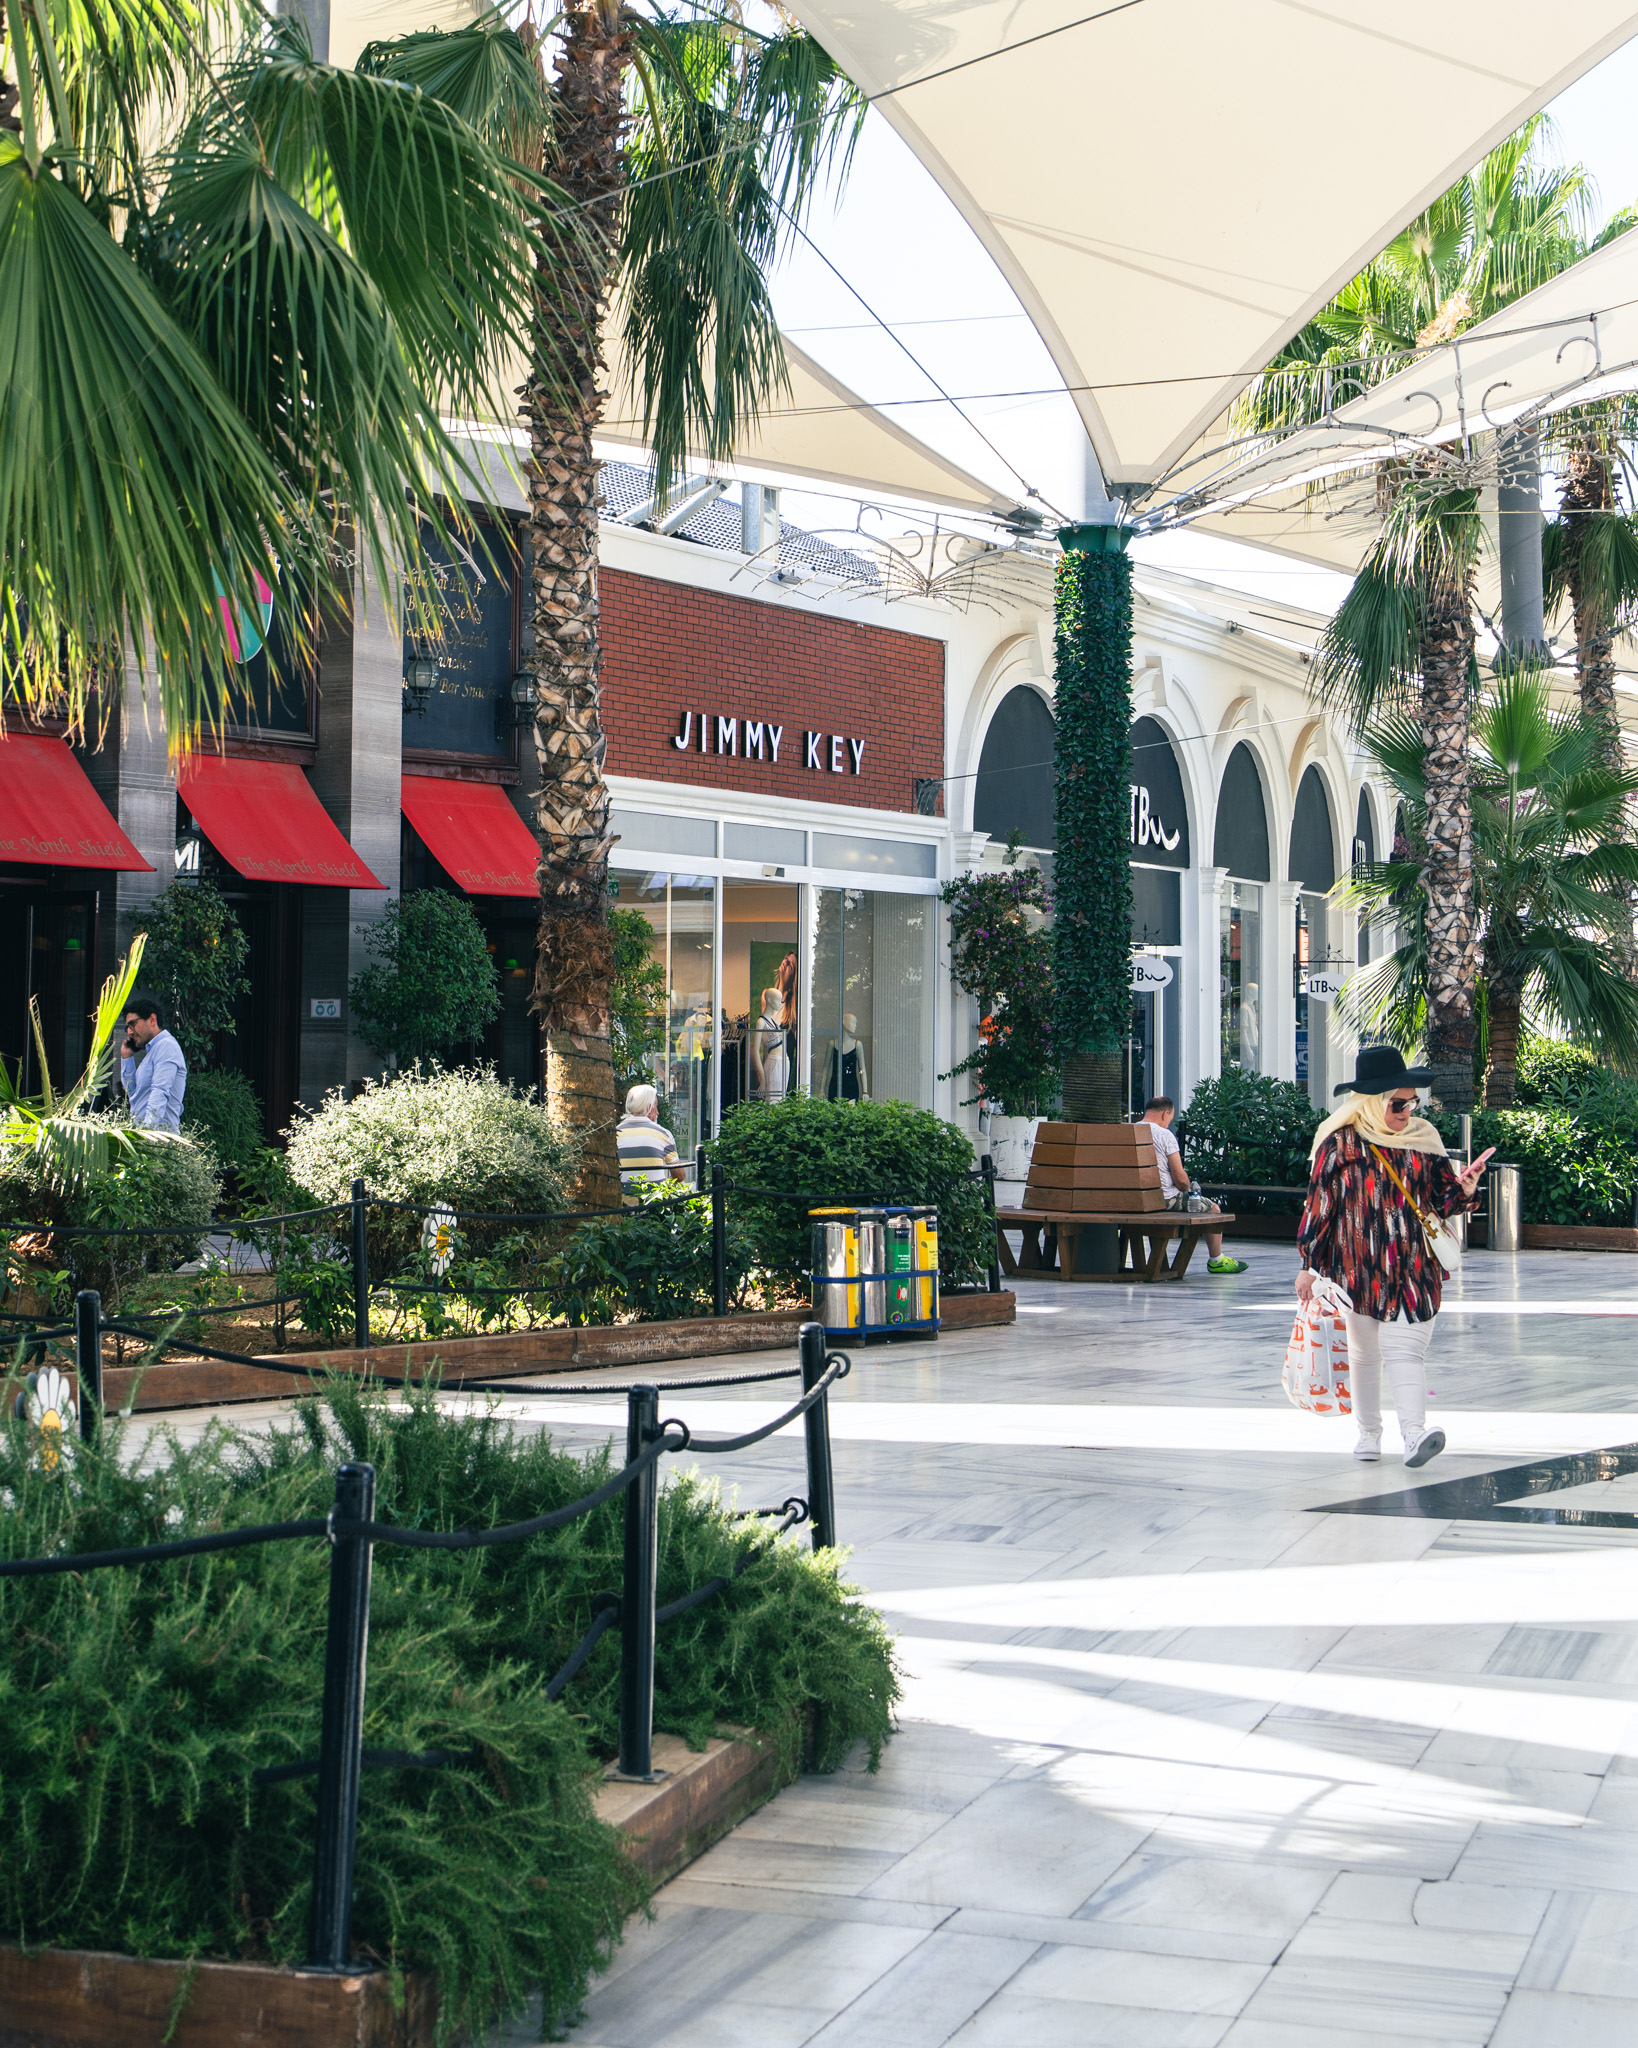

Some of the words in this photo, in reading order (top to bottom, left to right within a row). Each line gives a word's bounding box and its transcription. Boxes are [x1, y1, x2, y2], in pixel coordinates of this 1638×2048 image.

[439, 677, 460, 694] Bar
[671, 711, 783, 763] JIMMY
[804, 731, 865, 775] KEY
[20, 836, 73, 855] North
[78, 839, 127, 857] Shield
[237, 856, 269, 873] The
[268, 858, 314, 876] North
[317, 862, 361, 878] Shield
[457, 868, 485, 884] The
[484, 871, 526, 888] North
